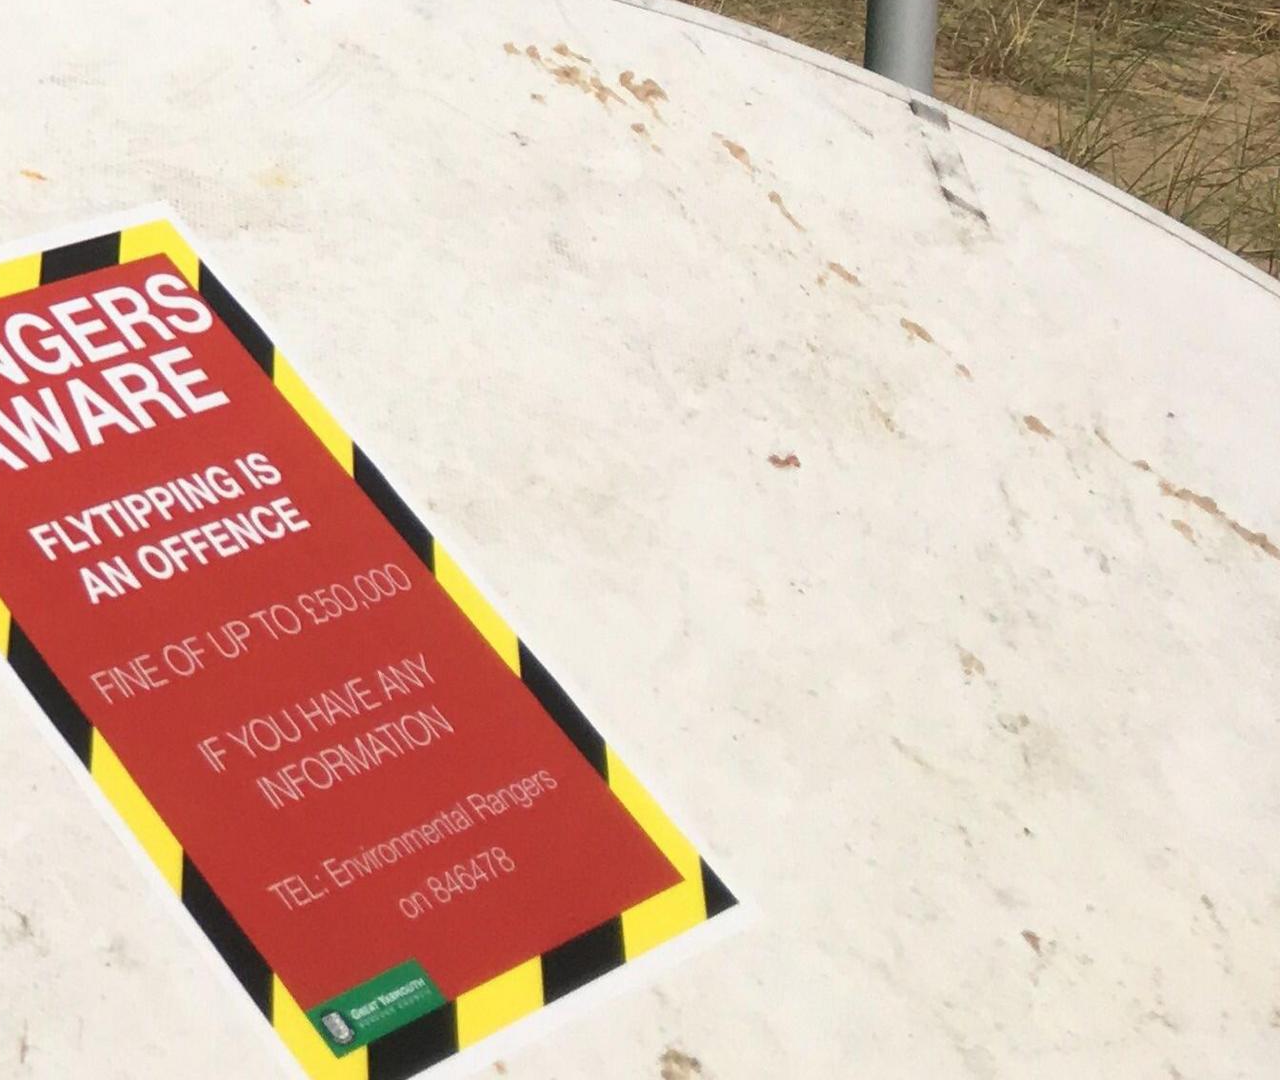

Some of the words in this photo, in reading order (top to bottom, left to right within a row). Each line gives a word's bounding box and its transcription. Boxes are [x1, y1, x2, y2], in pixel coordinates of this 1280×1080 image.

[29, 466, 244, 560] FLYTIPPING
[235, 453, 281, 489] IS
[80, 556, 141, 604] AN
[137, 497, 310, 579] OFFENCE
[90, 654, 169, 704] FINE
[163, 636, 204, 676] OF
[207, 621, 250, 658] UP
[249, 604, 301, 640] TO
[298, 563, 411, 625] £50,000
[198, 736, 226, 773] IF
[226, 710, 301, 757] YOU
[296, 678, 382, 731] HAVE
[377, 653, 434, 700] ANY
[256, 705, 454, 809] INFORMATION
[267, 875, 329, 910] TEL:
[321, 803, 474, 888] Environmental
[466, 770, 557, 819] Rangers
[399, 892, 432, 919] on
[427, 847, 515, 903] 846478
[351, 1000, 380, 1020] GREAT
[378, 978, 426, 1006] YARMOUTH
